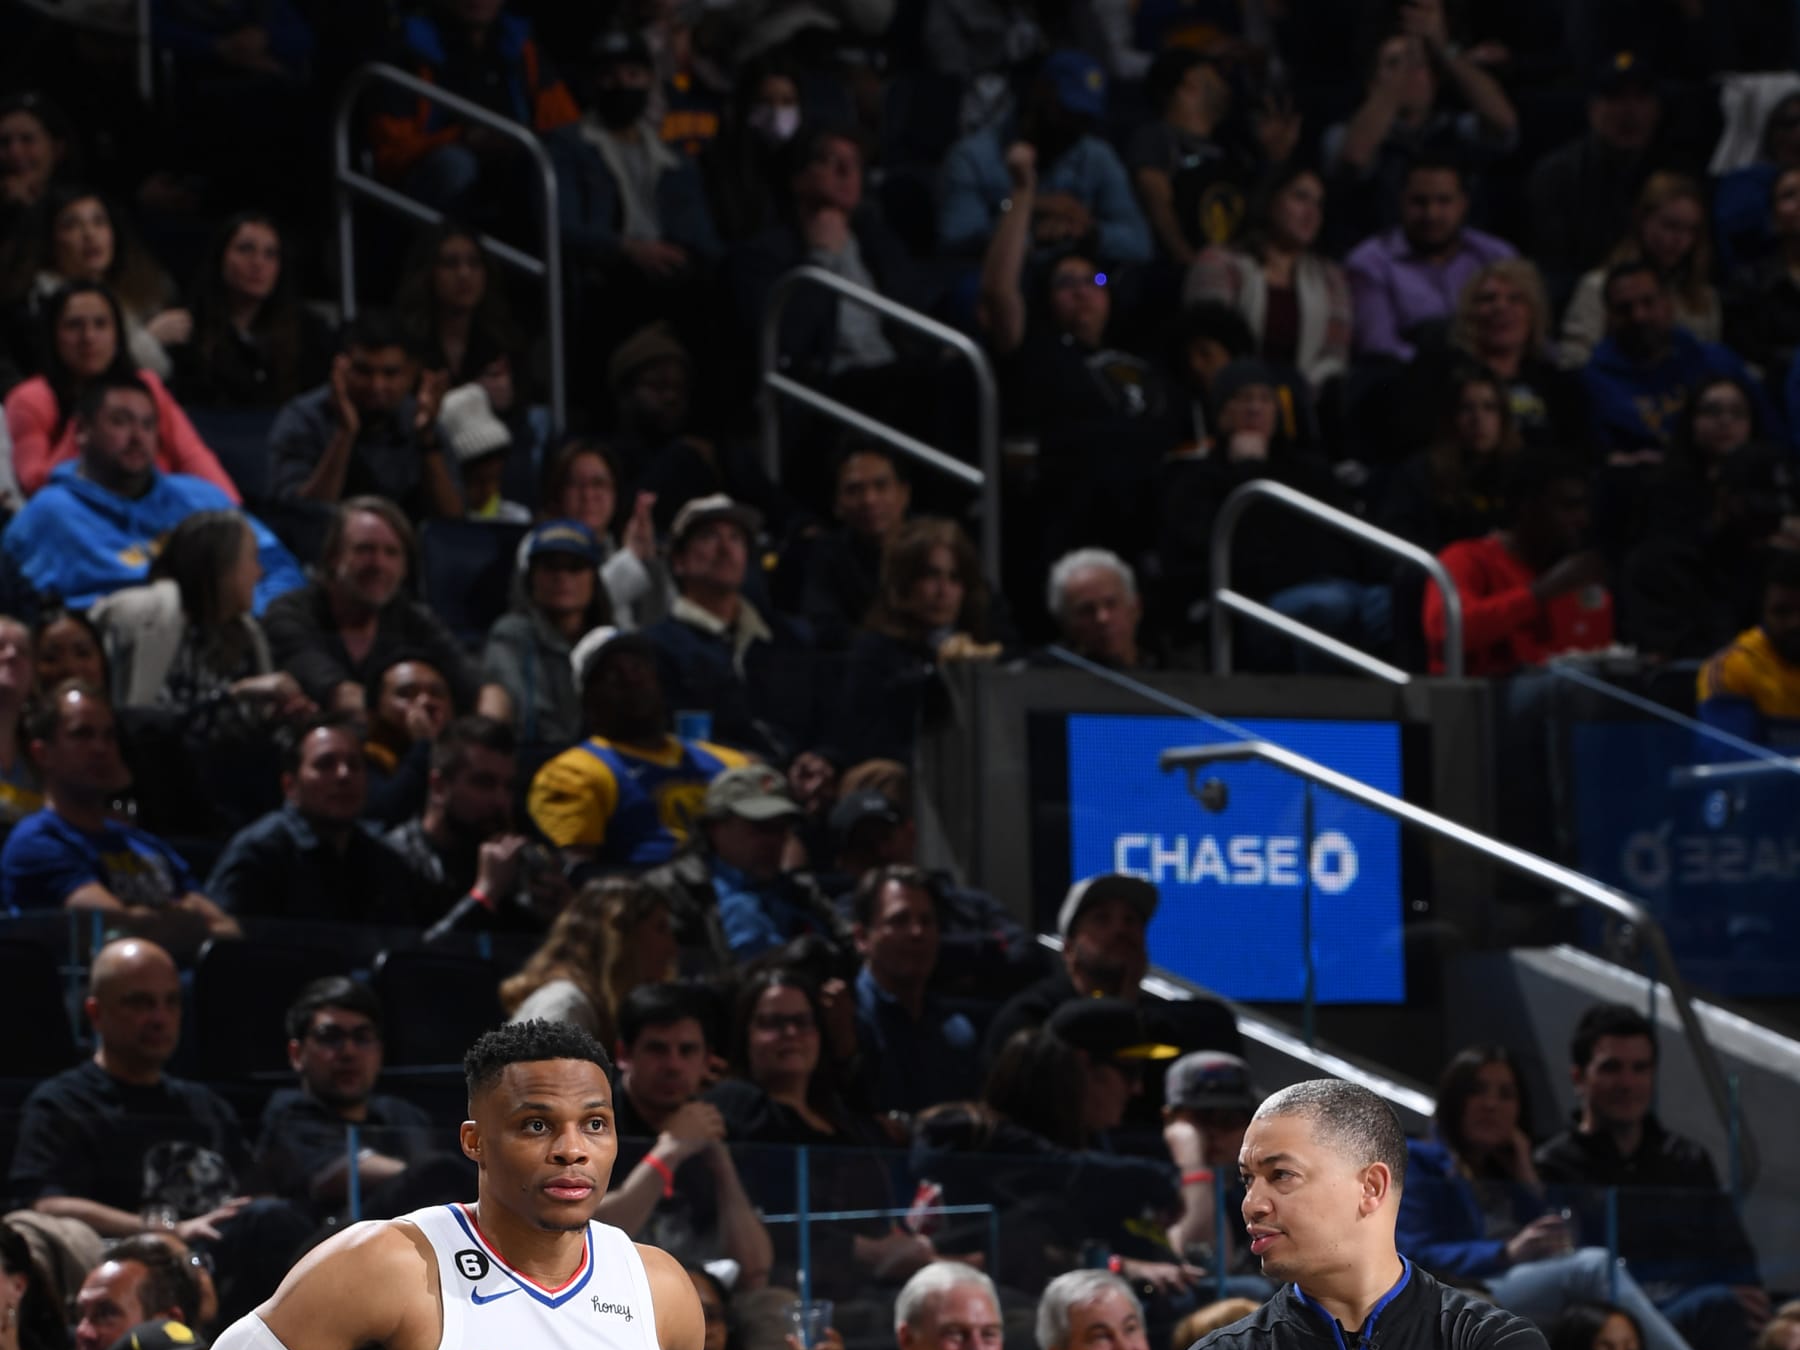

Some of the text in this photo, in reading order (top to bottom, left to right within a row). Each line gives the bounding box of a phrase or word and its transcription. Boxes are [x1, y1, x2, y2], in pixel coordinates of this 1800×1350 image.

[1115, 833, 1302, 886] CHASE
[460, 1254, 482, 1277] 6
[591, 1295, 633, 1322] honey
